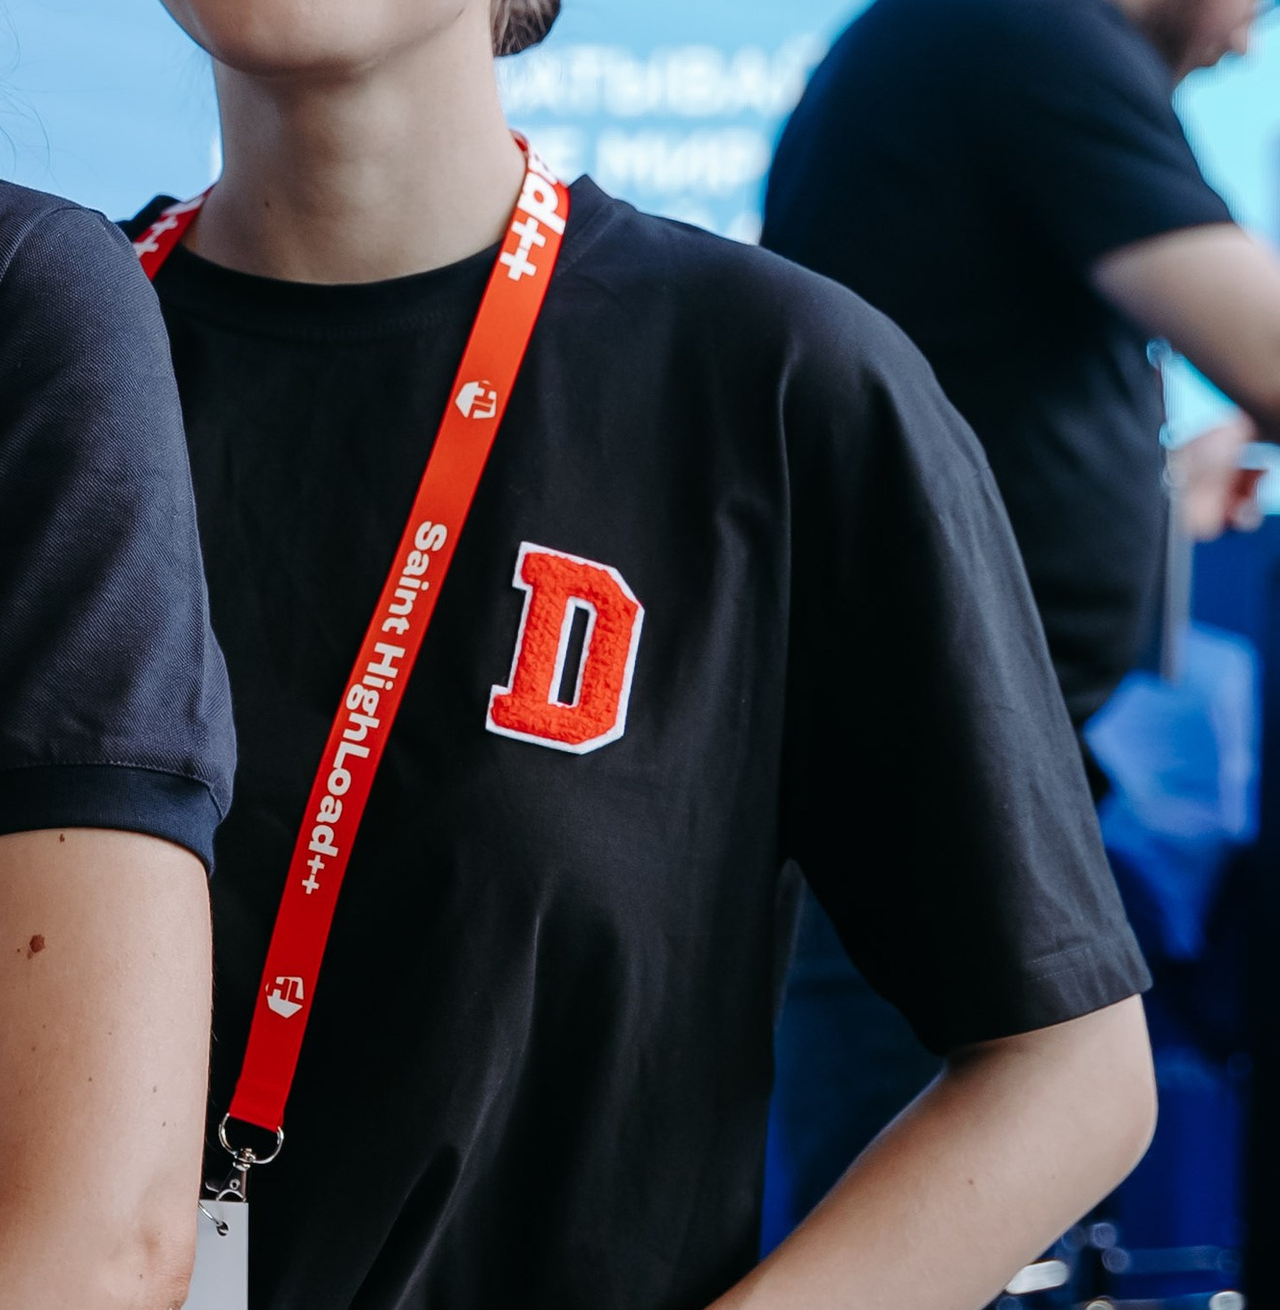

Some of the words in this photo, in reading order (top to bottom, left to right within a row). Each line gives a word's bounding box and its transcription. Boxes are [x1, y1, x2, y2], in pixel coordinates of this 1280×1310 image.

[381, 521, 448, 635] Saint
[485, 541, 646, 755] D
[301, 641, 406, 895] HighLoad++
